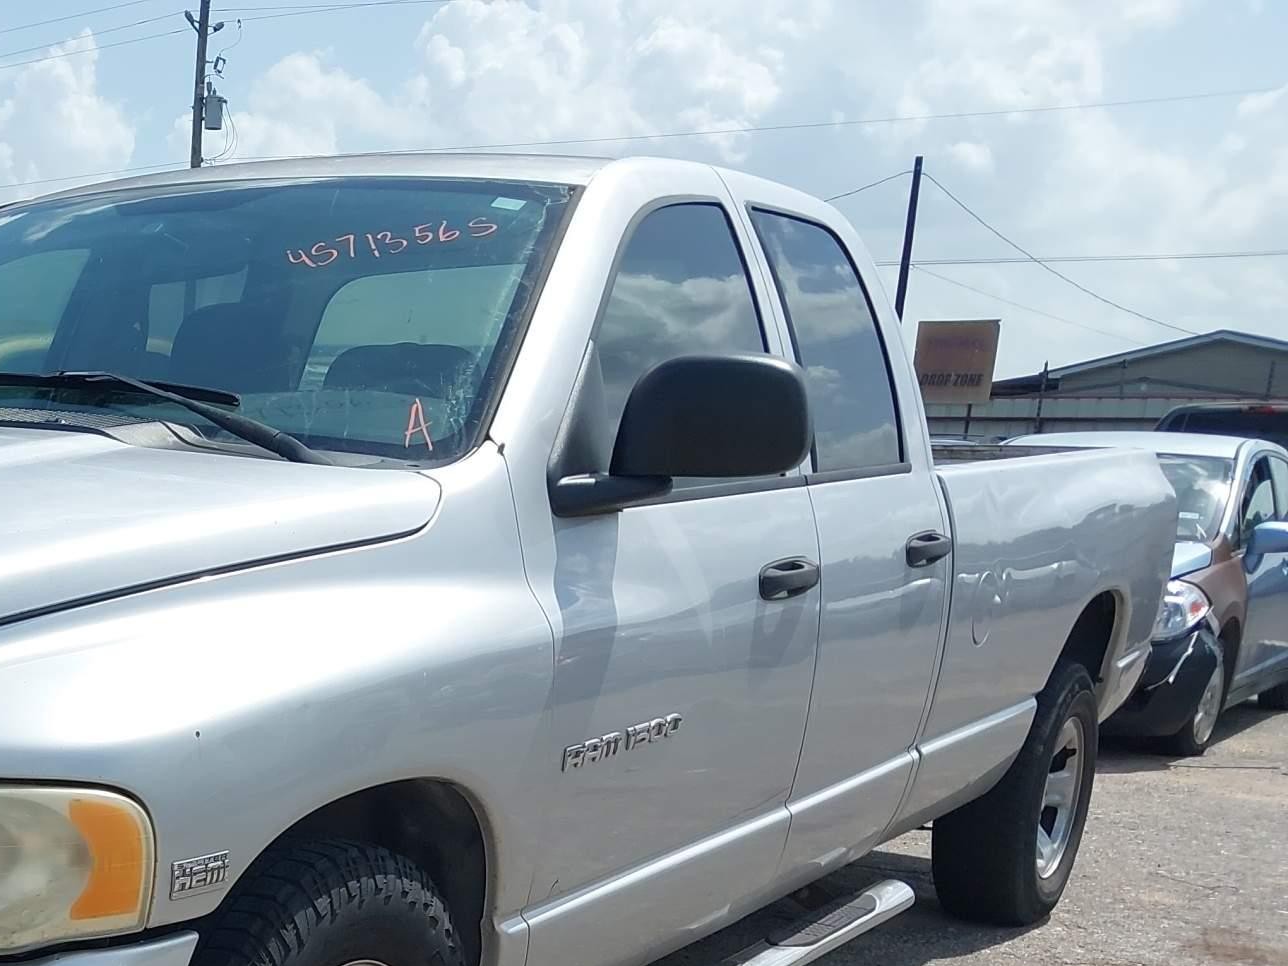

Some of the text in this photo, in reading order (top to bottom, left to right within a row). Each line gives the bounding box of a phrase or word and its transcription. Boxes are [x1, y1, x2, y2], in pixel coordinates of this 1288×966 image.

[952, 373, 984, 386] ZONE
[404, 398, 433, 452] A
[625, 713, 683, 751] 1500
[173, 859, 230, 892] HEMI
